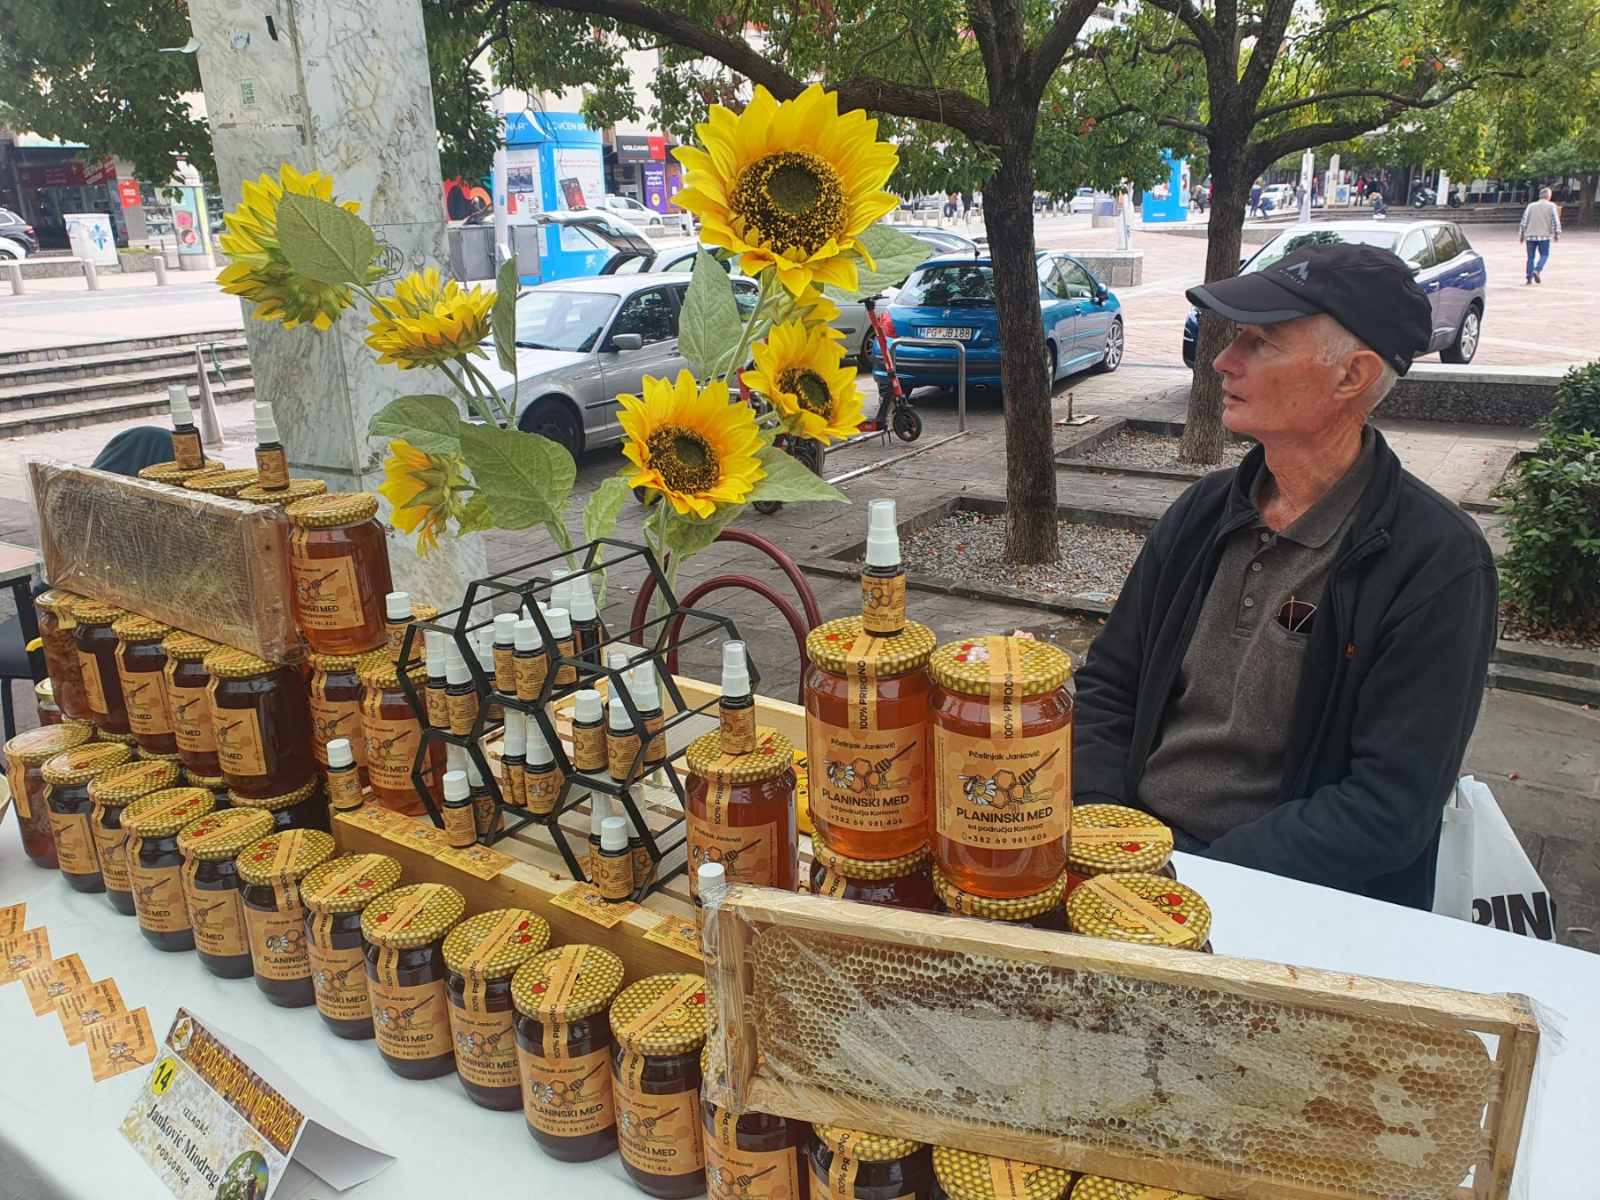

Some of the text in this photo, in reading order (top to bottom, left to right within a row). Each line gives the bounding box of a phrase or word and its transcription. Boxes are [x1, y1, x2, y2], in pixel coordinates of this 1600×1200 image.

[822, 787, 910, 808] PLANINSKI MED
[955, 806, 1053, 824] PLANINSKI MED
[346, 992, 367, 1004] MED
[409, 1032, 433, 1043] MED
[154, 1062, 175, 1092] 14
[579, 1103, 604, 1117] MED
[146, 1103, 220, 1190] Janković Miodrag
[653, 1148, 677, 1157] MED
[156, 1143, 191, 1187] PODGORICA
